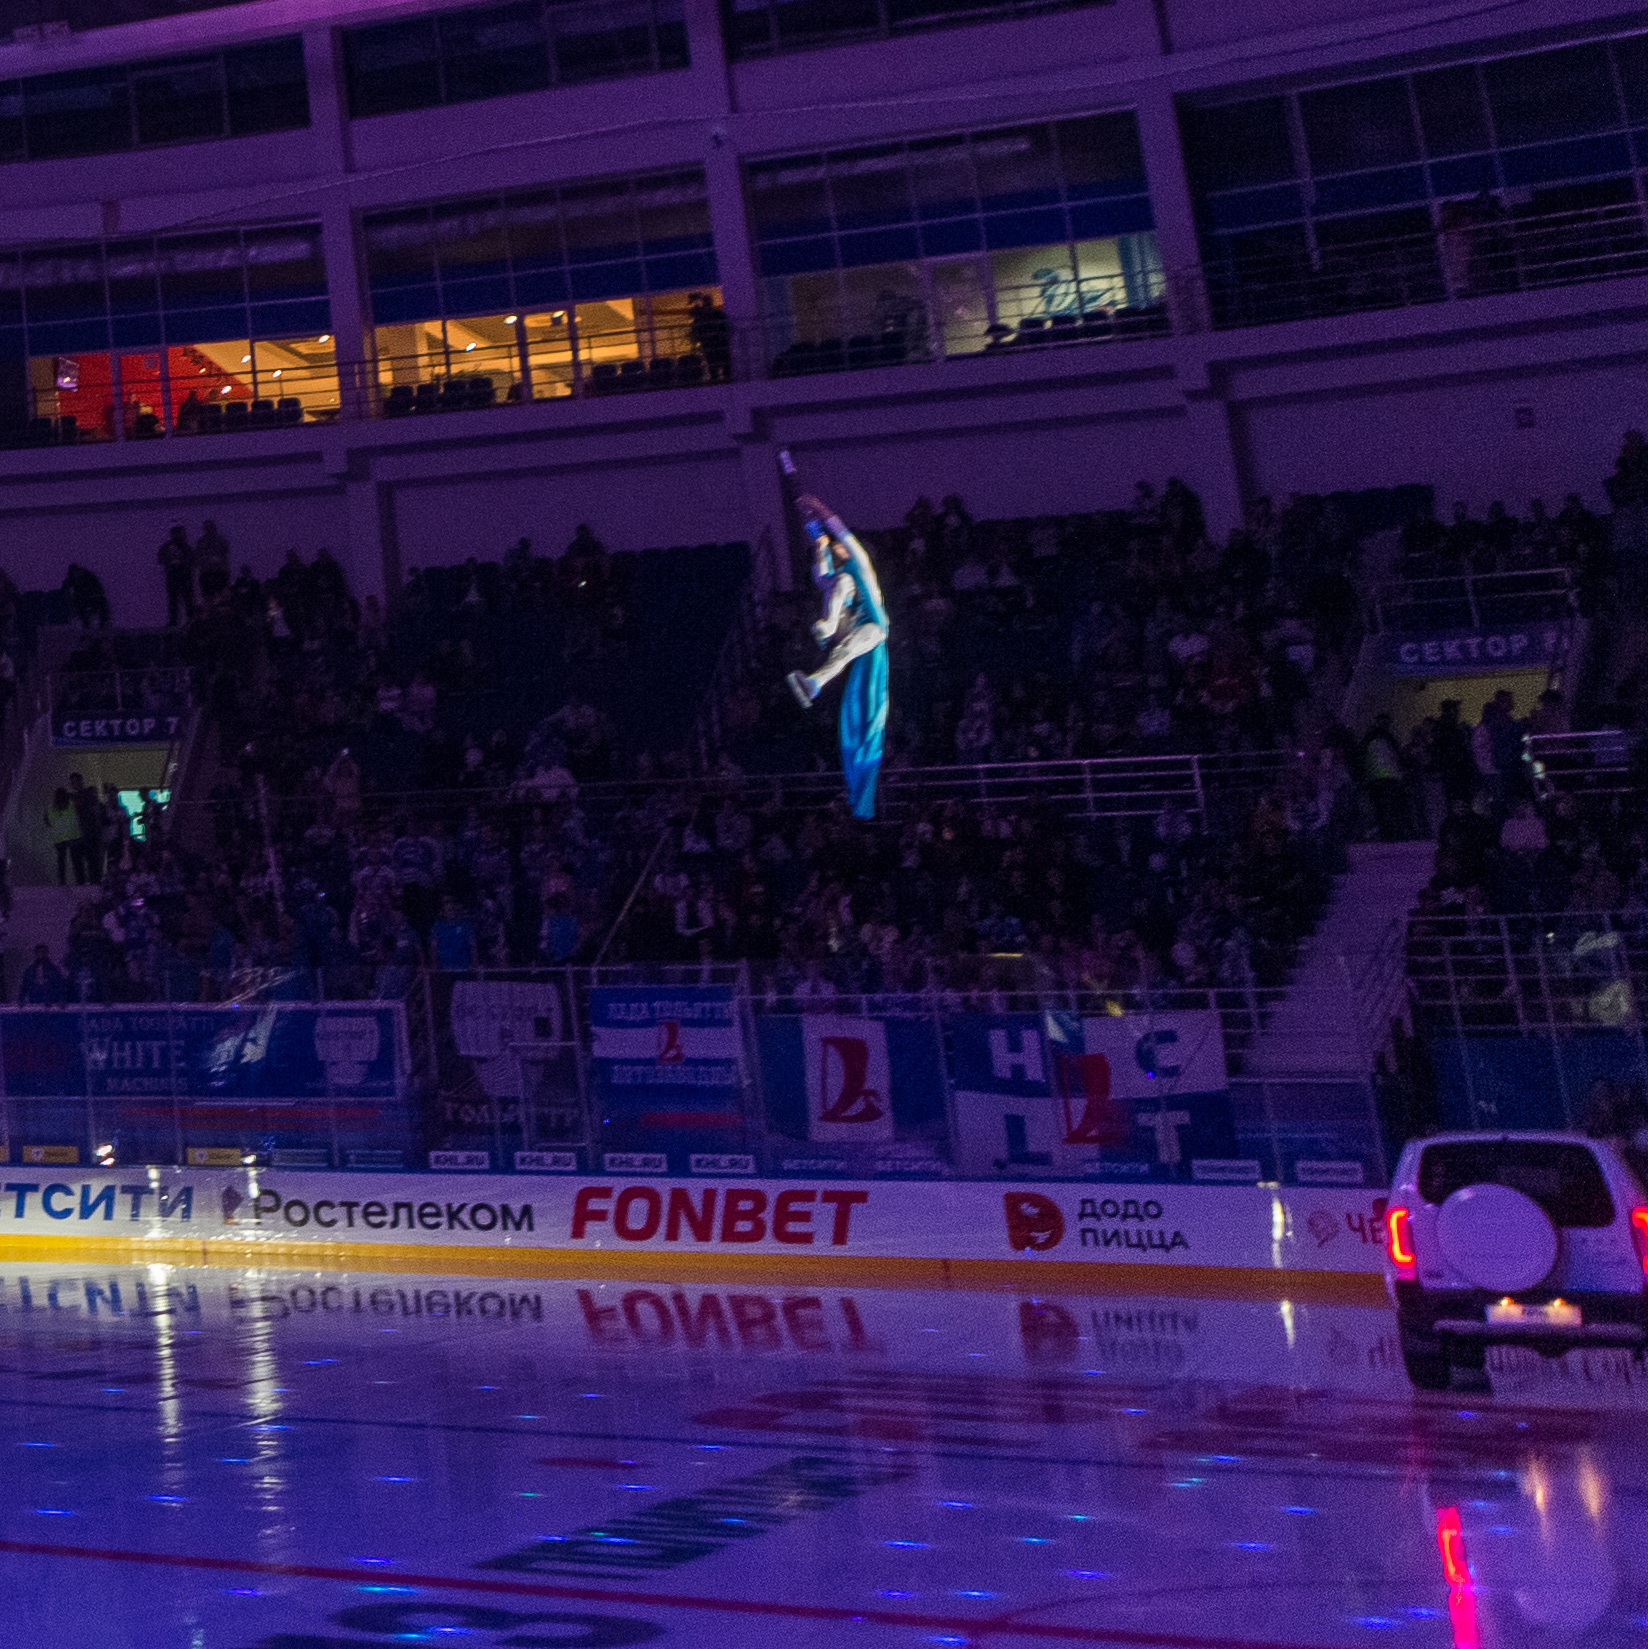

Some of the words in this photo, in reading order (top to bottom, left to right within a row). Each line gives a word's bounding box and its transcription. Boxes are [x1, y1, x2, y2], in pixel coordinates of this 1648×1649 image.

[1398, 633, 1530, 664] СЕКТОР
[62, 717, 157, 739] СЕКТОР
[257, 1188, 535, 1232] Ростелеком
[570, 1185, 869, 1246] FONBET
[1078, 1197, 1164, 1223] ДОДО
[1079, 1226, 1191, 1253] ПИЦЦА
